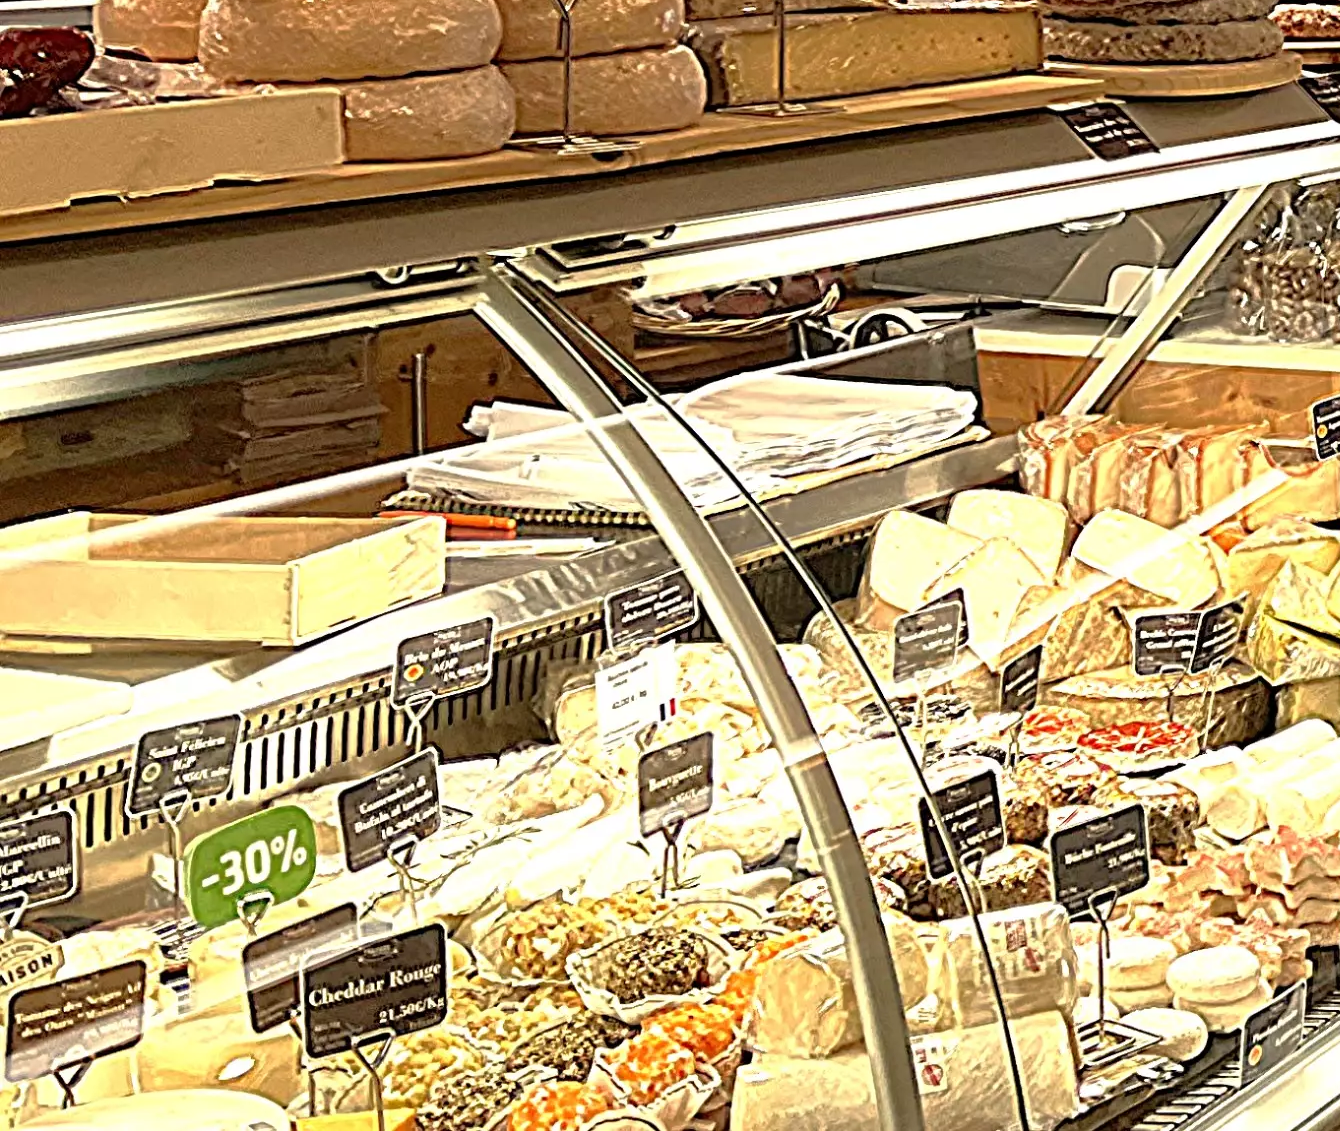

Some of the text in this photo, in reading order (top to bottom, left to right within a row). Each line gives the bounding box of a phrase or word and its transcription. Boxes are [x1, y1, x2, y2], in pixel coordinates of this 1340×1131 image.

[201, 828, 308, 897] -30%
[308, 963, 442, 1008] Cheddar Rouge
